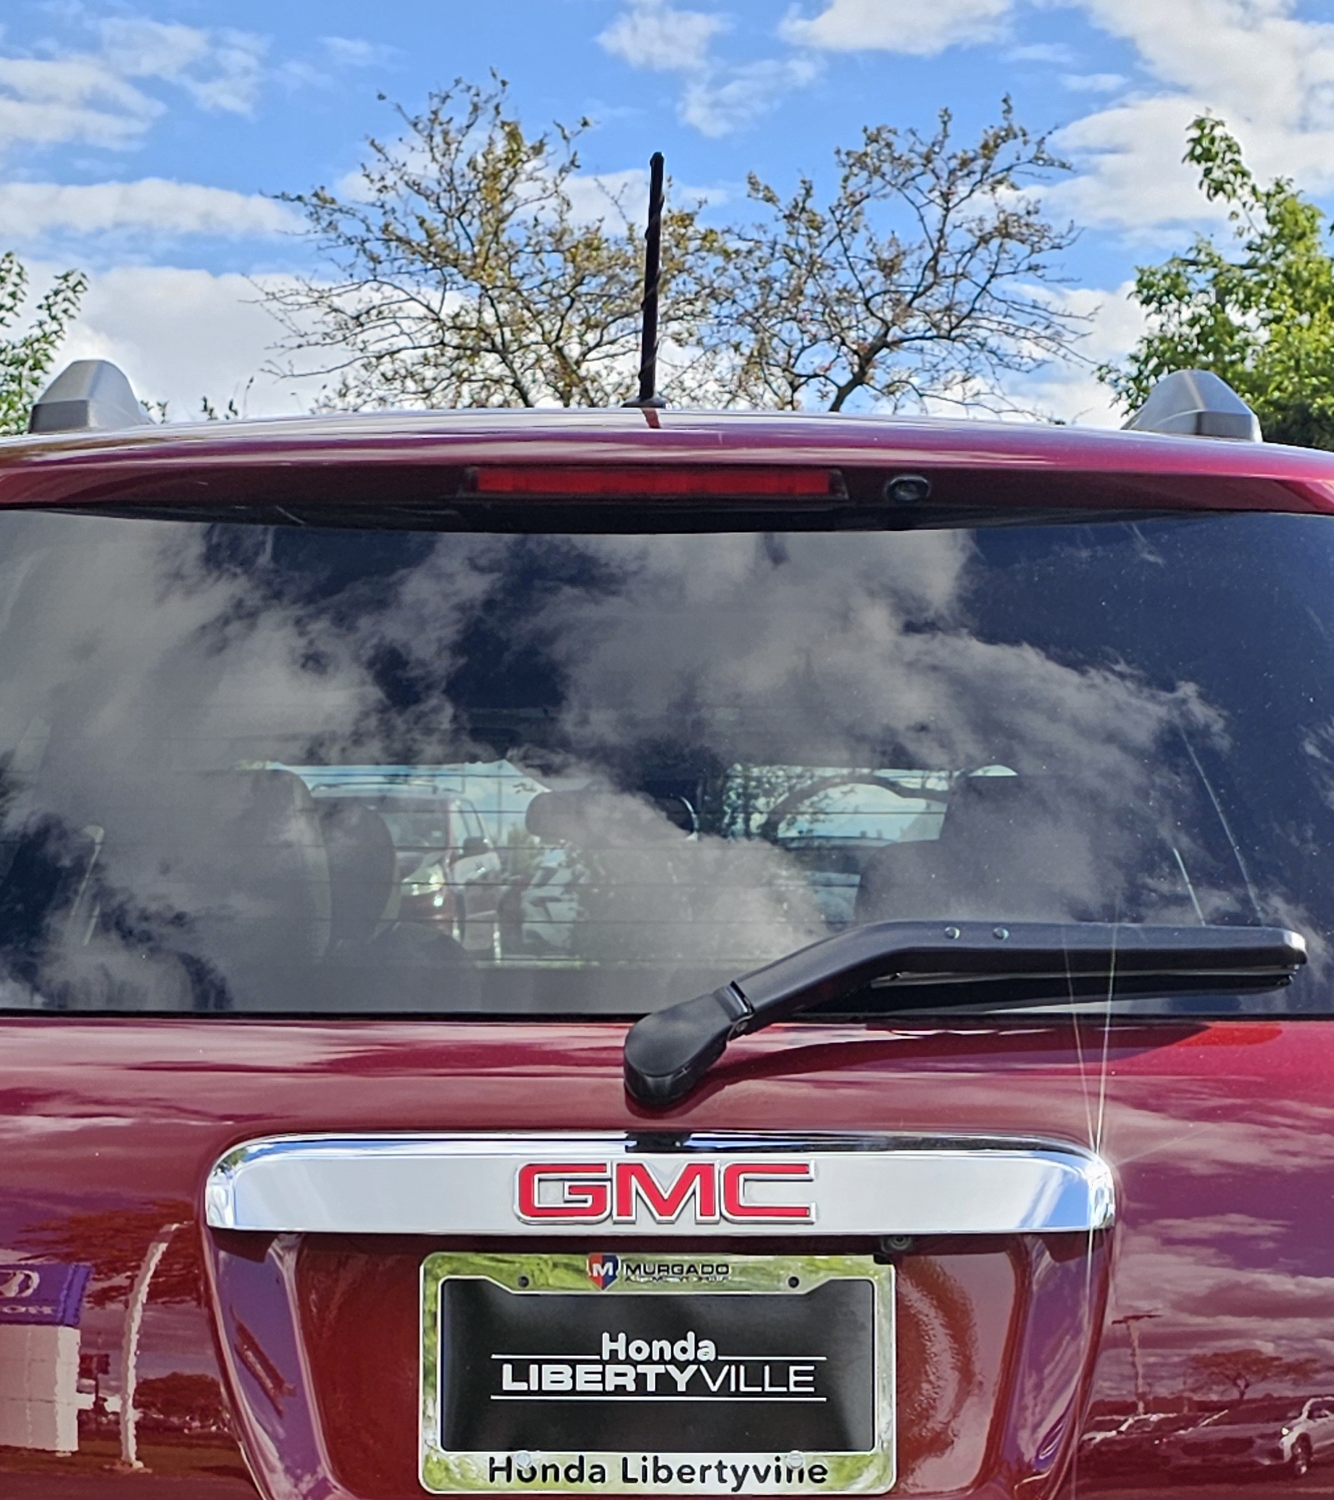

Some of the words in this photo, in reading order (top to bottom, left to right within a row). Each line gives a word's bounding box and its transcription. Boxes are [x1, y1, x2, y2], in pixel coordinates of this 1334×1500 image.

[514, 1160, 816, 1225] GMC
[624, 1263, 730, 1276] MURGADO
[601, 1331, 717, 1362] Honda
[501, 1364, 816, 1393] LIBERTYVILLE
[489, 1454, 606, 1484] Honda
